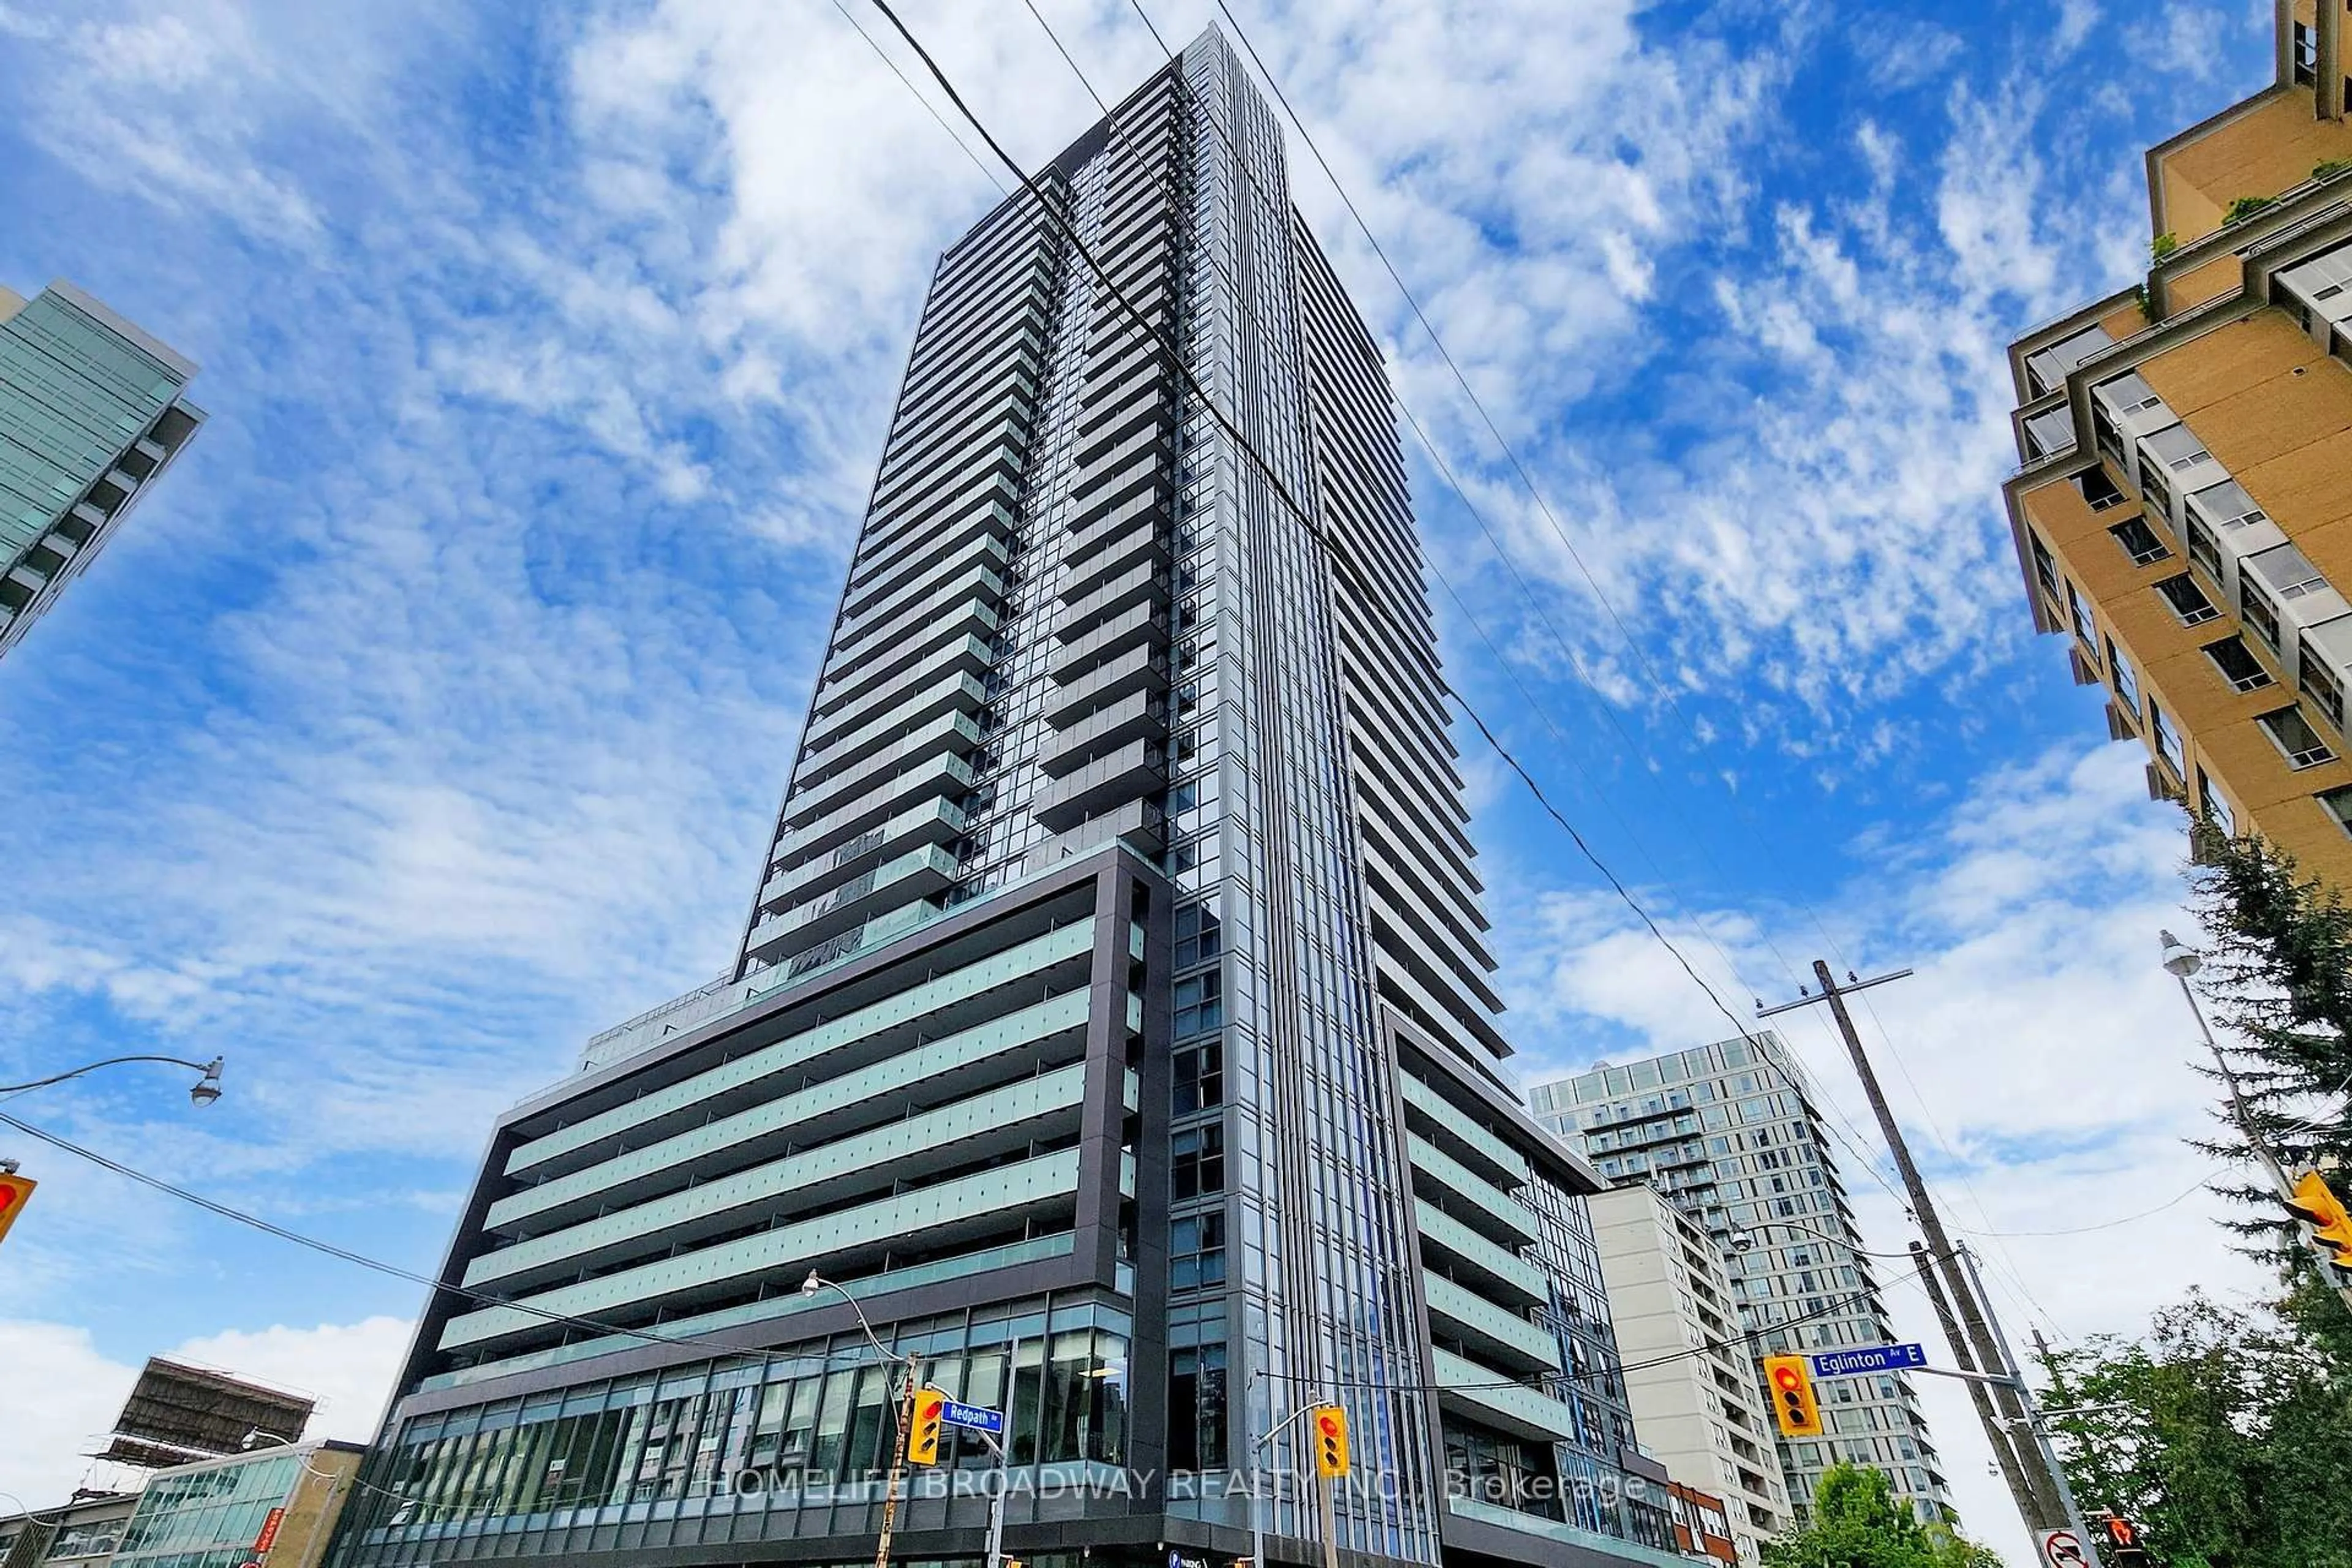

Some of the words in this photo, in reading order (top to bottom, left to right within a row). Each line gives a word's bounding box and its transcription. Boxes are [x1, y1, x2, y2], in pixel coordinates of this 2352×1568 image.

[1819, 1353, 1886, 1374] Eglinton
[1890, 1348, 1901, 1357] Av
[1906, 1346, 1920, 1362] E
[951, 1404, 988, 1425] Redpath
